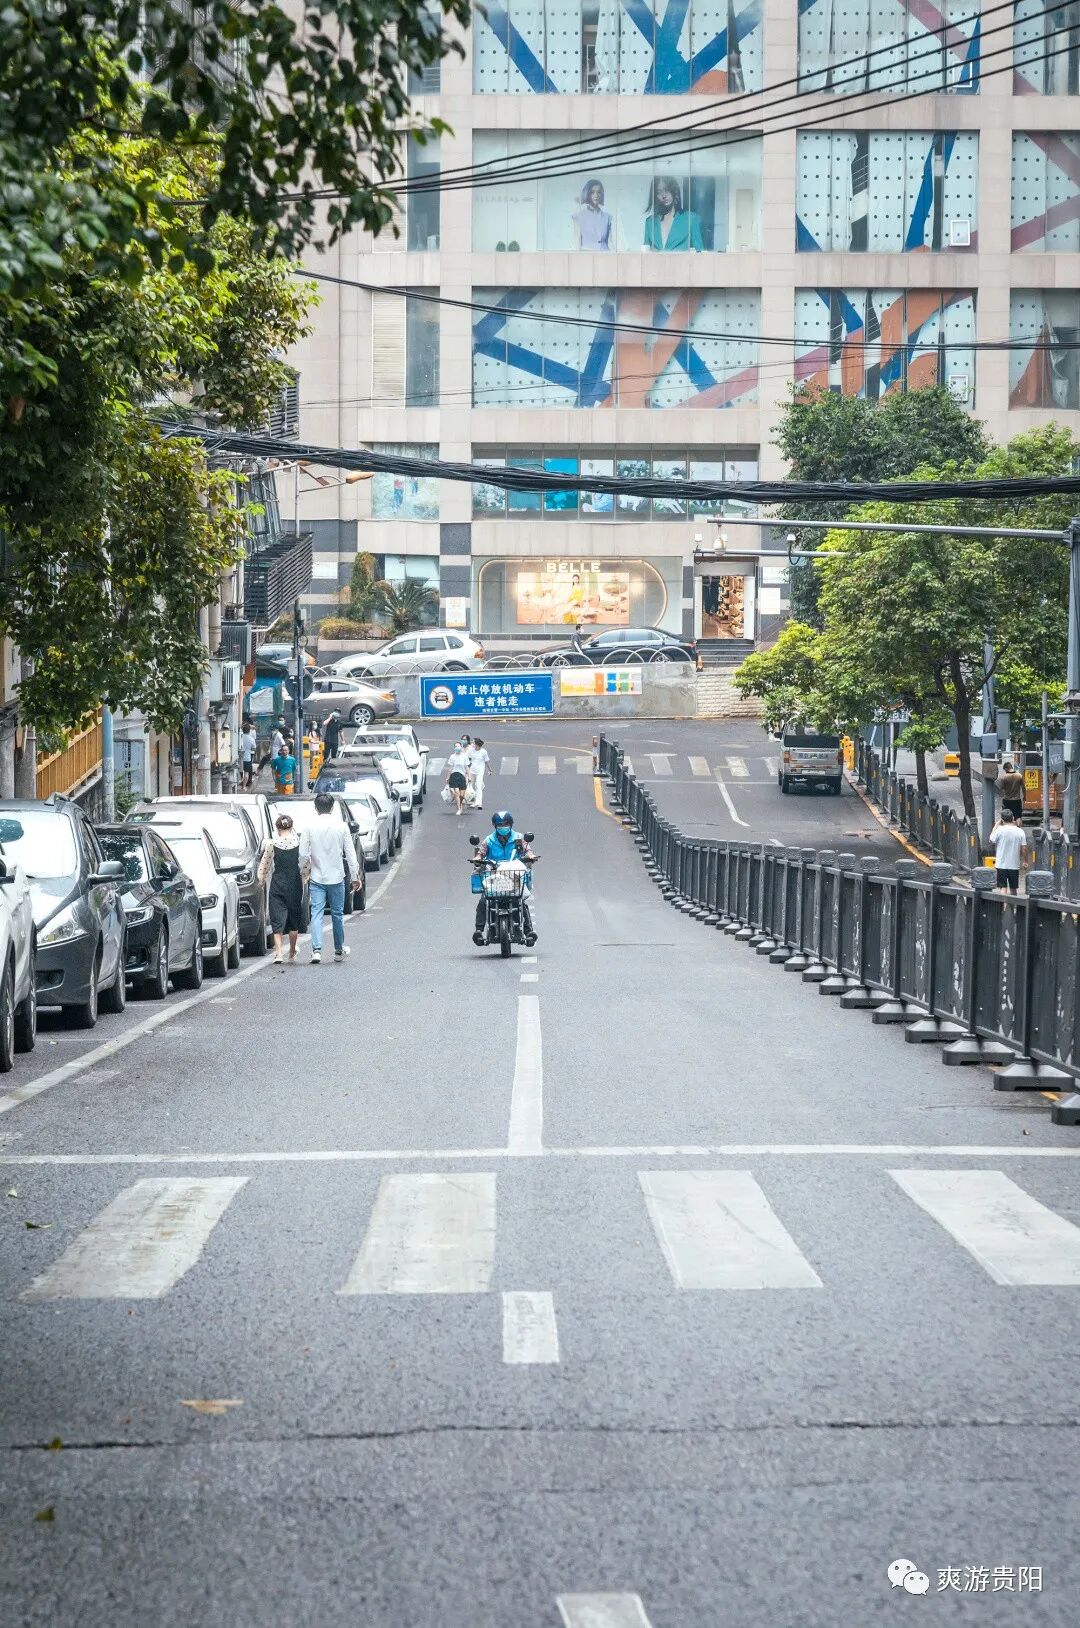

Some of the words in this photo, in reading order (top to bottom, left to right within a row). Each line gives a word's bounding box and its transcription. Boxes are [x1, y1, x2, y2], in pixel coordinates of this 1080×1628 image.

[546, 562, 601, 573] BELLE
[457, 683, 536, 696] 禁止停放机动车
[474, 695, 519, 707] 违者拖走
